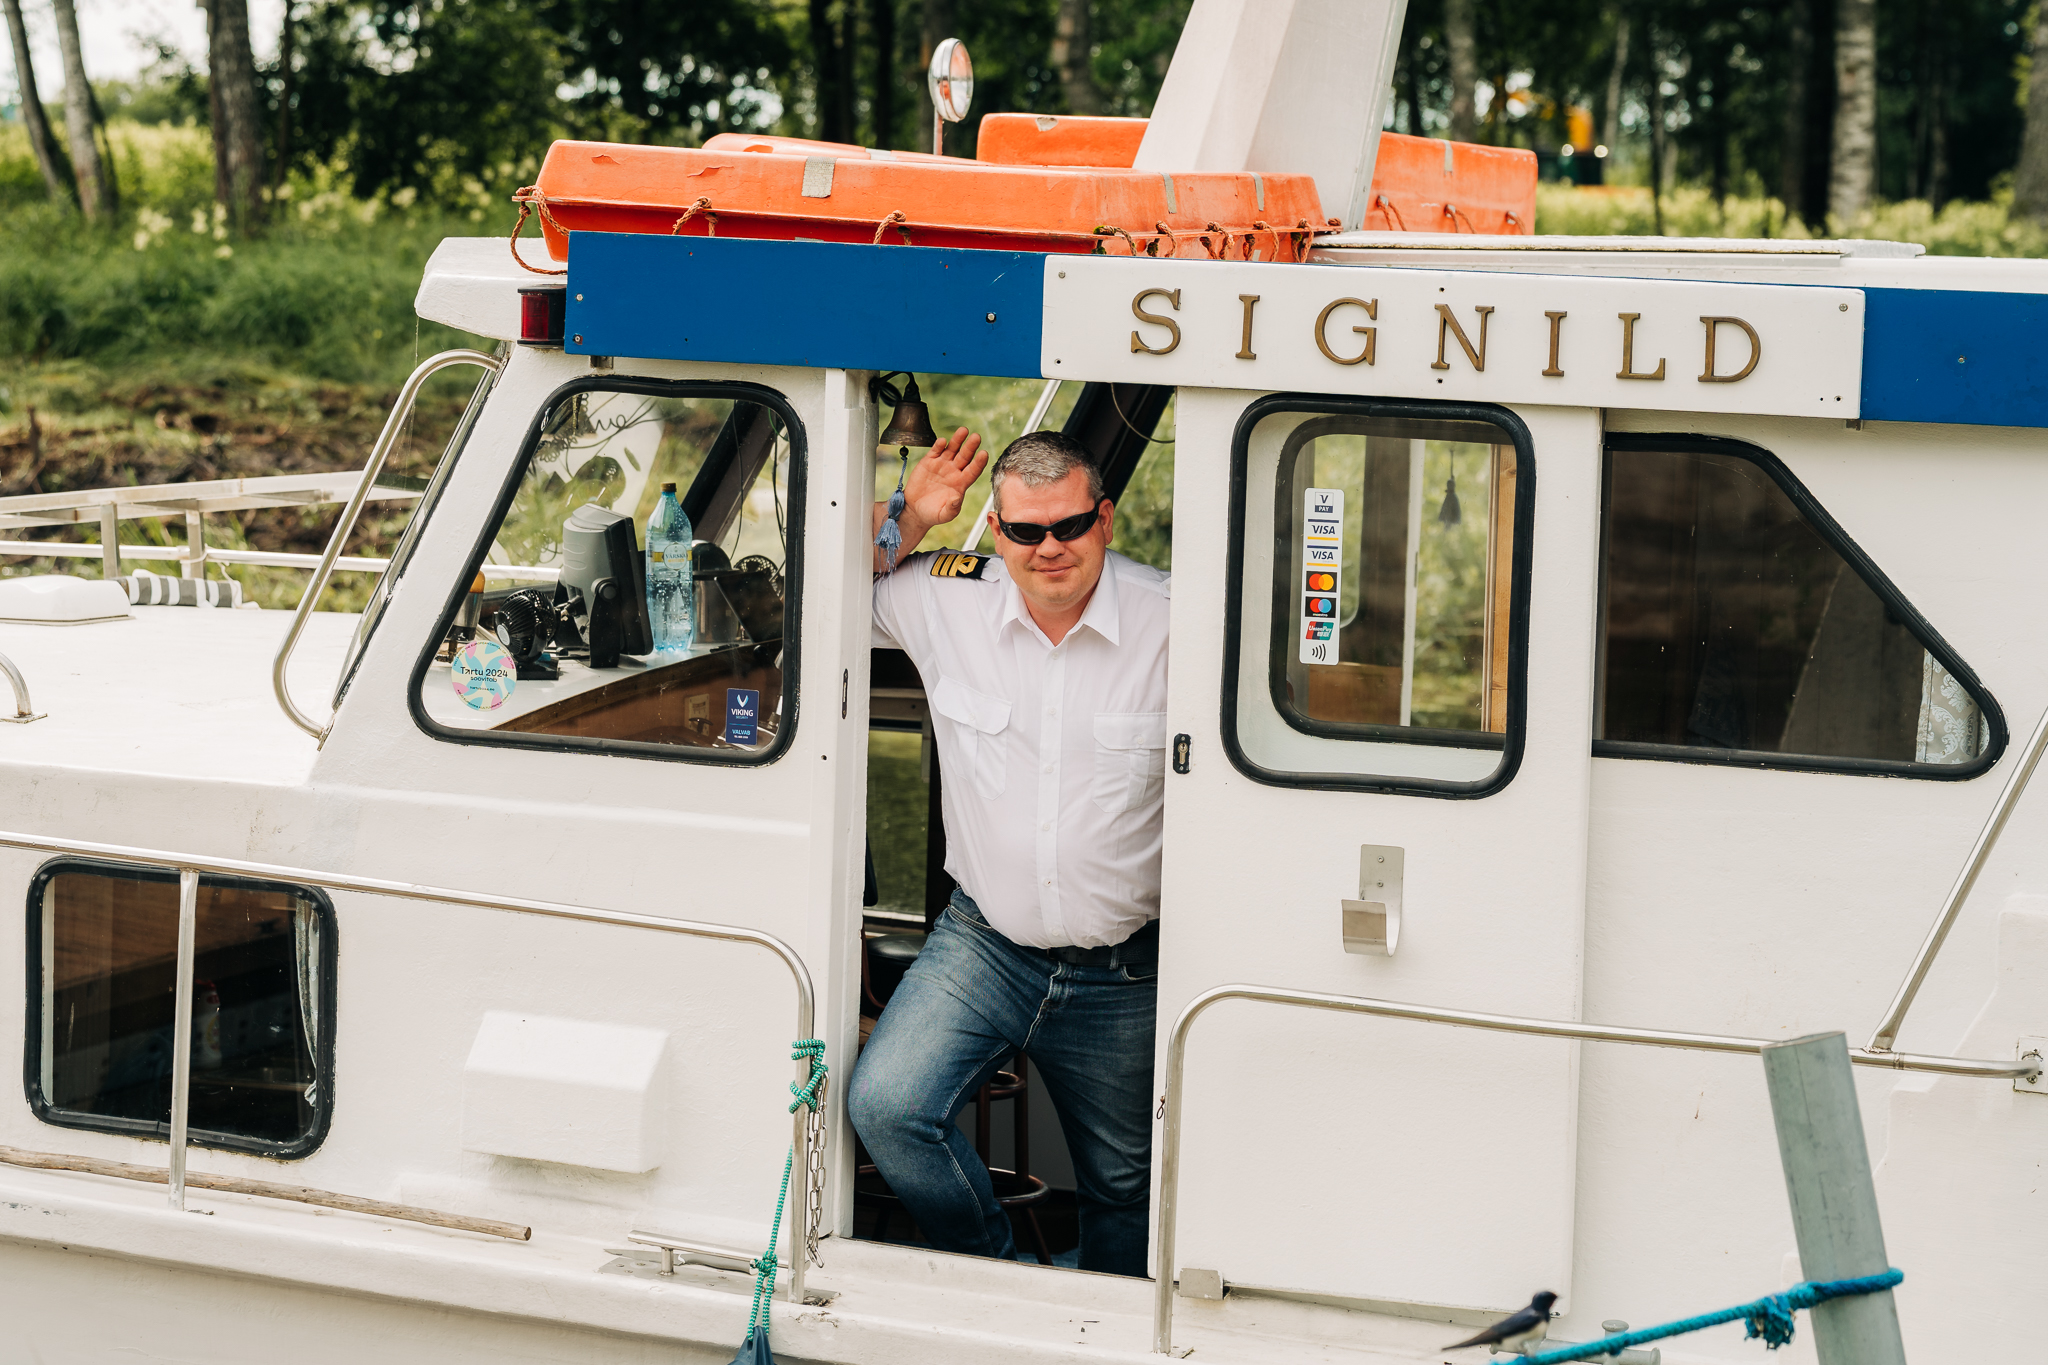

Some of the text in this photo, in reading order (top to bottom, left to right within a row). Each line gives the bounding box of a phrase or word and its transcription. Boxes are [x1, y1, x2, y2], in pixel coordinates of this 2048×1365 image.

[1130, 286, 1762, 383] SIGNILD
[1320, 494, 1329, 504] V
[1311, 524, 1336, 535] VISA
[1311, 550, 1334, 560] VISA
[460, 667, 508, 677] Tartu 2024
[731, 708, 753, 717] VIKING
